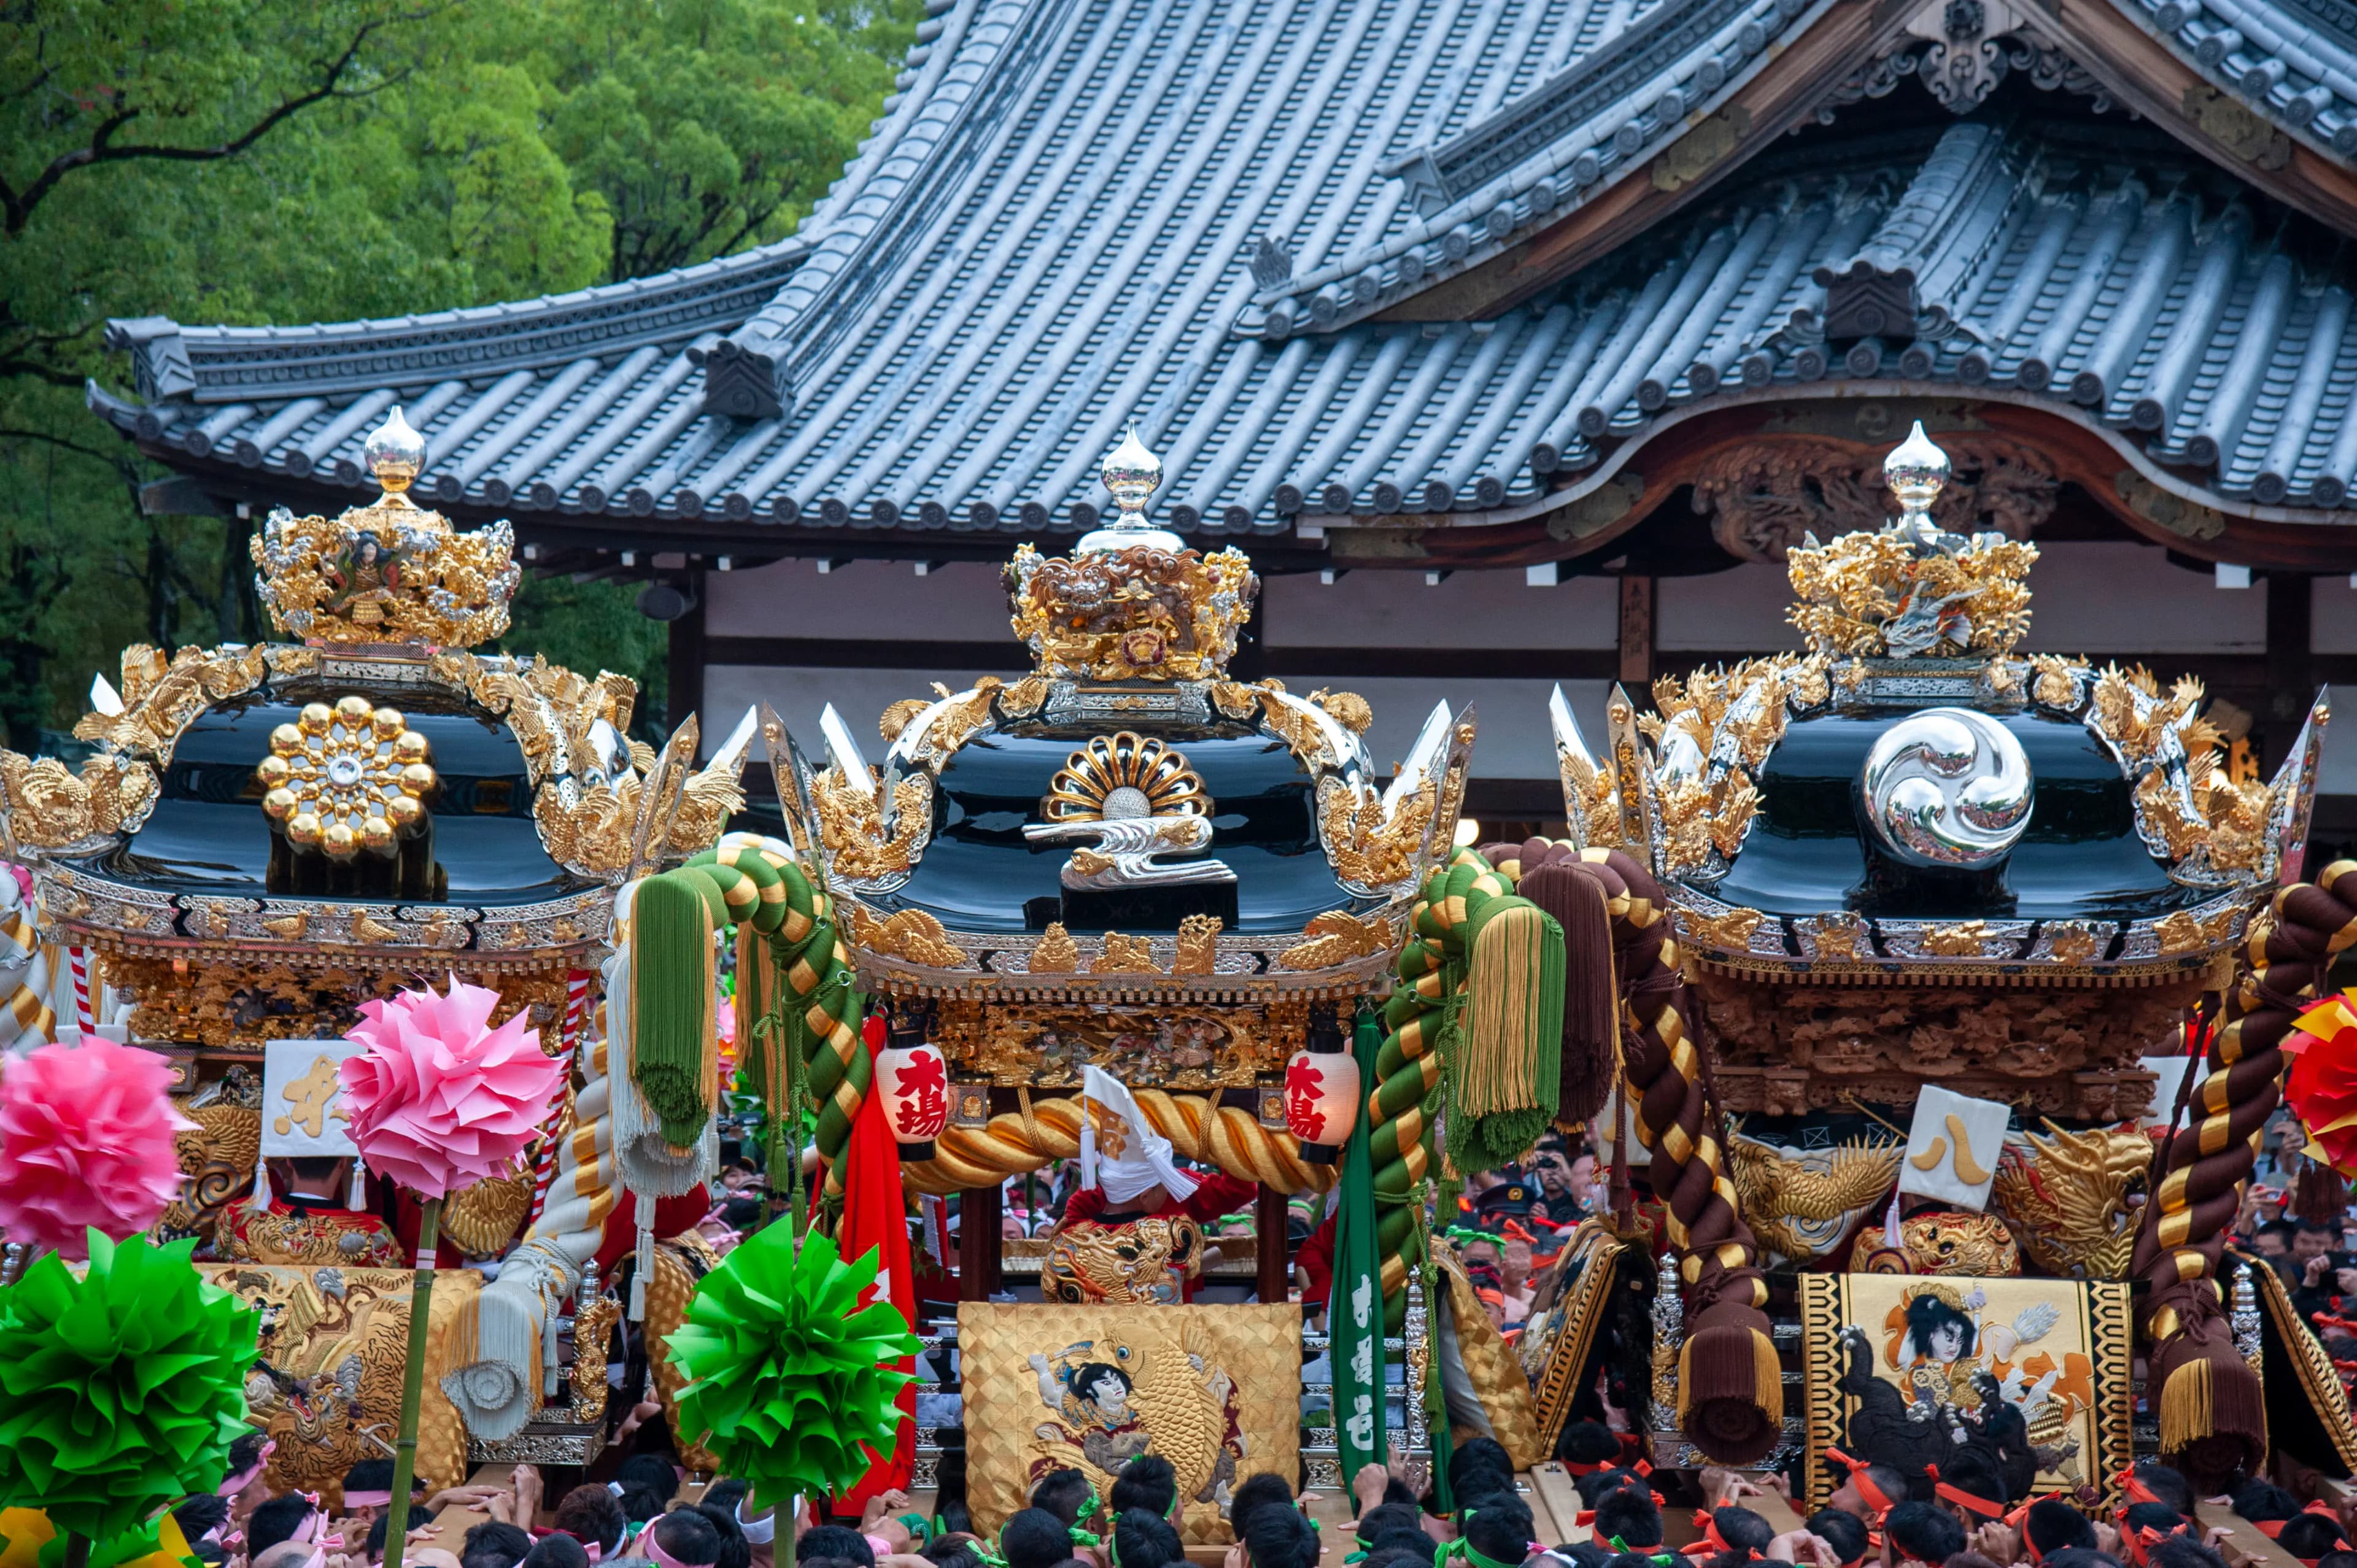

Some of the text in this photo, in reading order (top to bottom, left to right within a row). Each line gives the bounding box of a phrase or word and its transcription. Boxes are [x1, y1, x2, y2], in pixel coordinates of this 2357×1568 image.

[894, 1050, 947, 1138] 木場
[1285, 1056, 1326, 1141] 木場
[1910, 1114, 1991, 1186] 八
